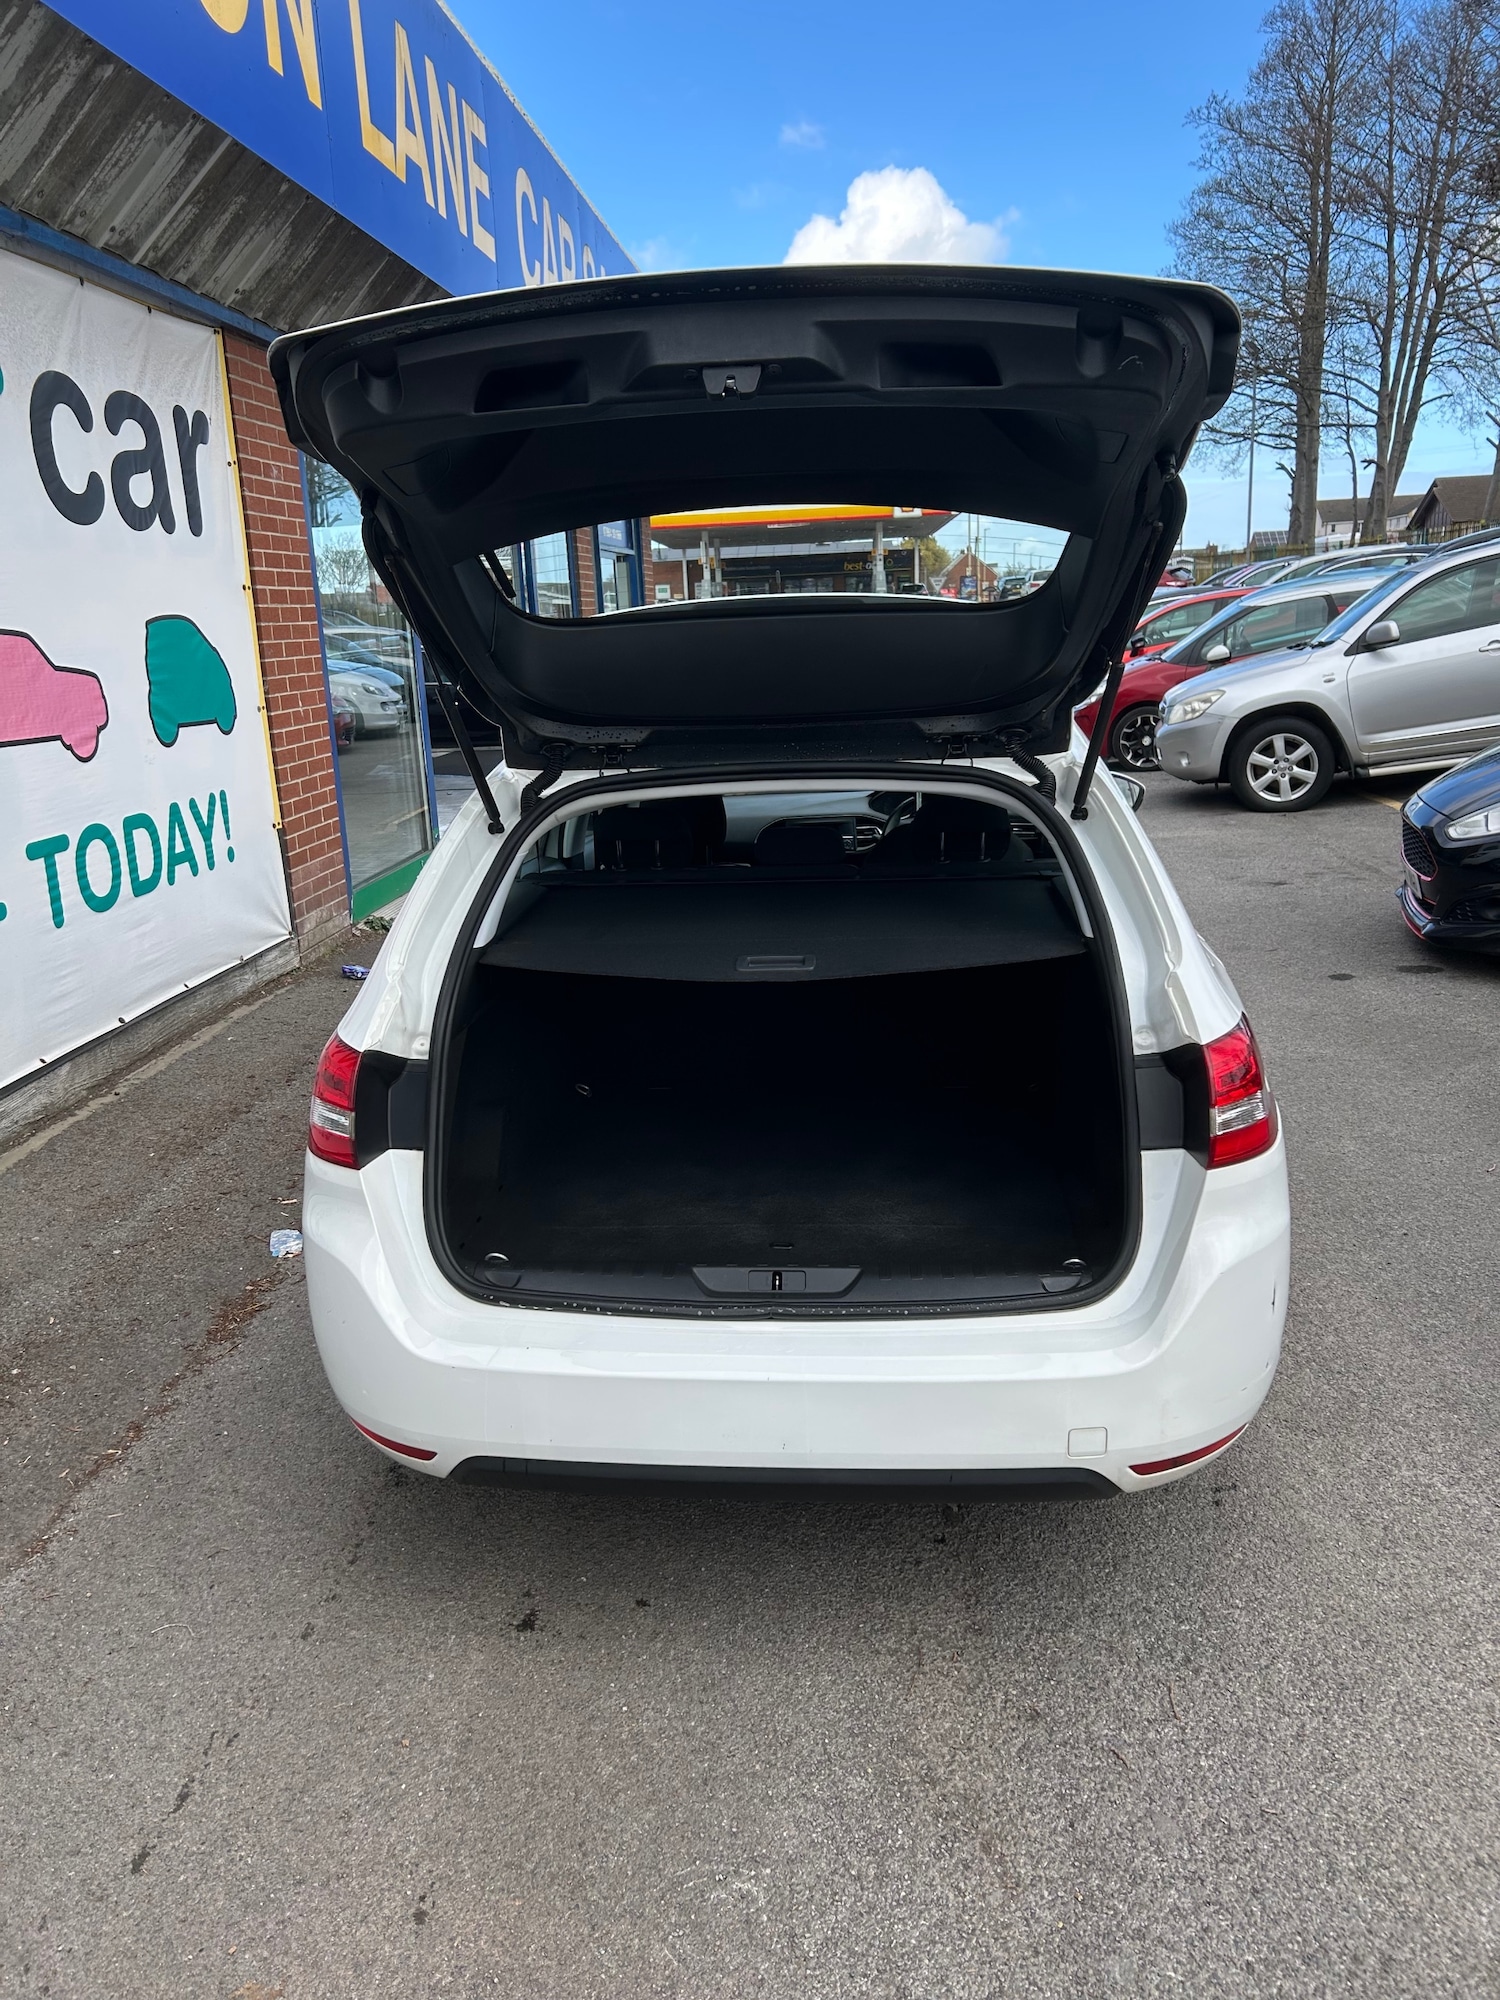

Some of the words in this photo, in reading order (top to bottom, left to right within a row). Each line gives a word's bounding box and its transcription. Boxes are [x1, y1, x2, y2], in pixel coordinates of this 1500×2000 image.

[348, 0, 497, 264] LANE
[30, 370, 210, 537] car
[843, 561, 873, 571] best-o
[26, 789, 235, 929] TODAY!
